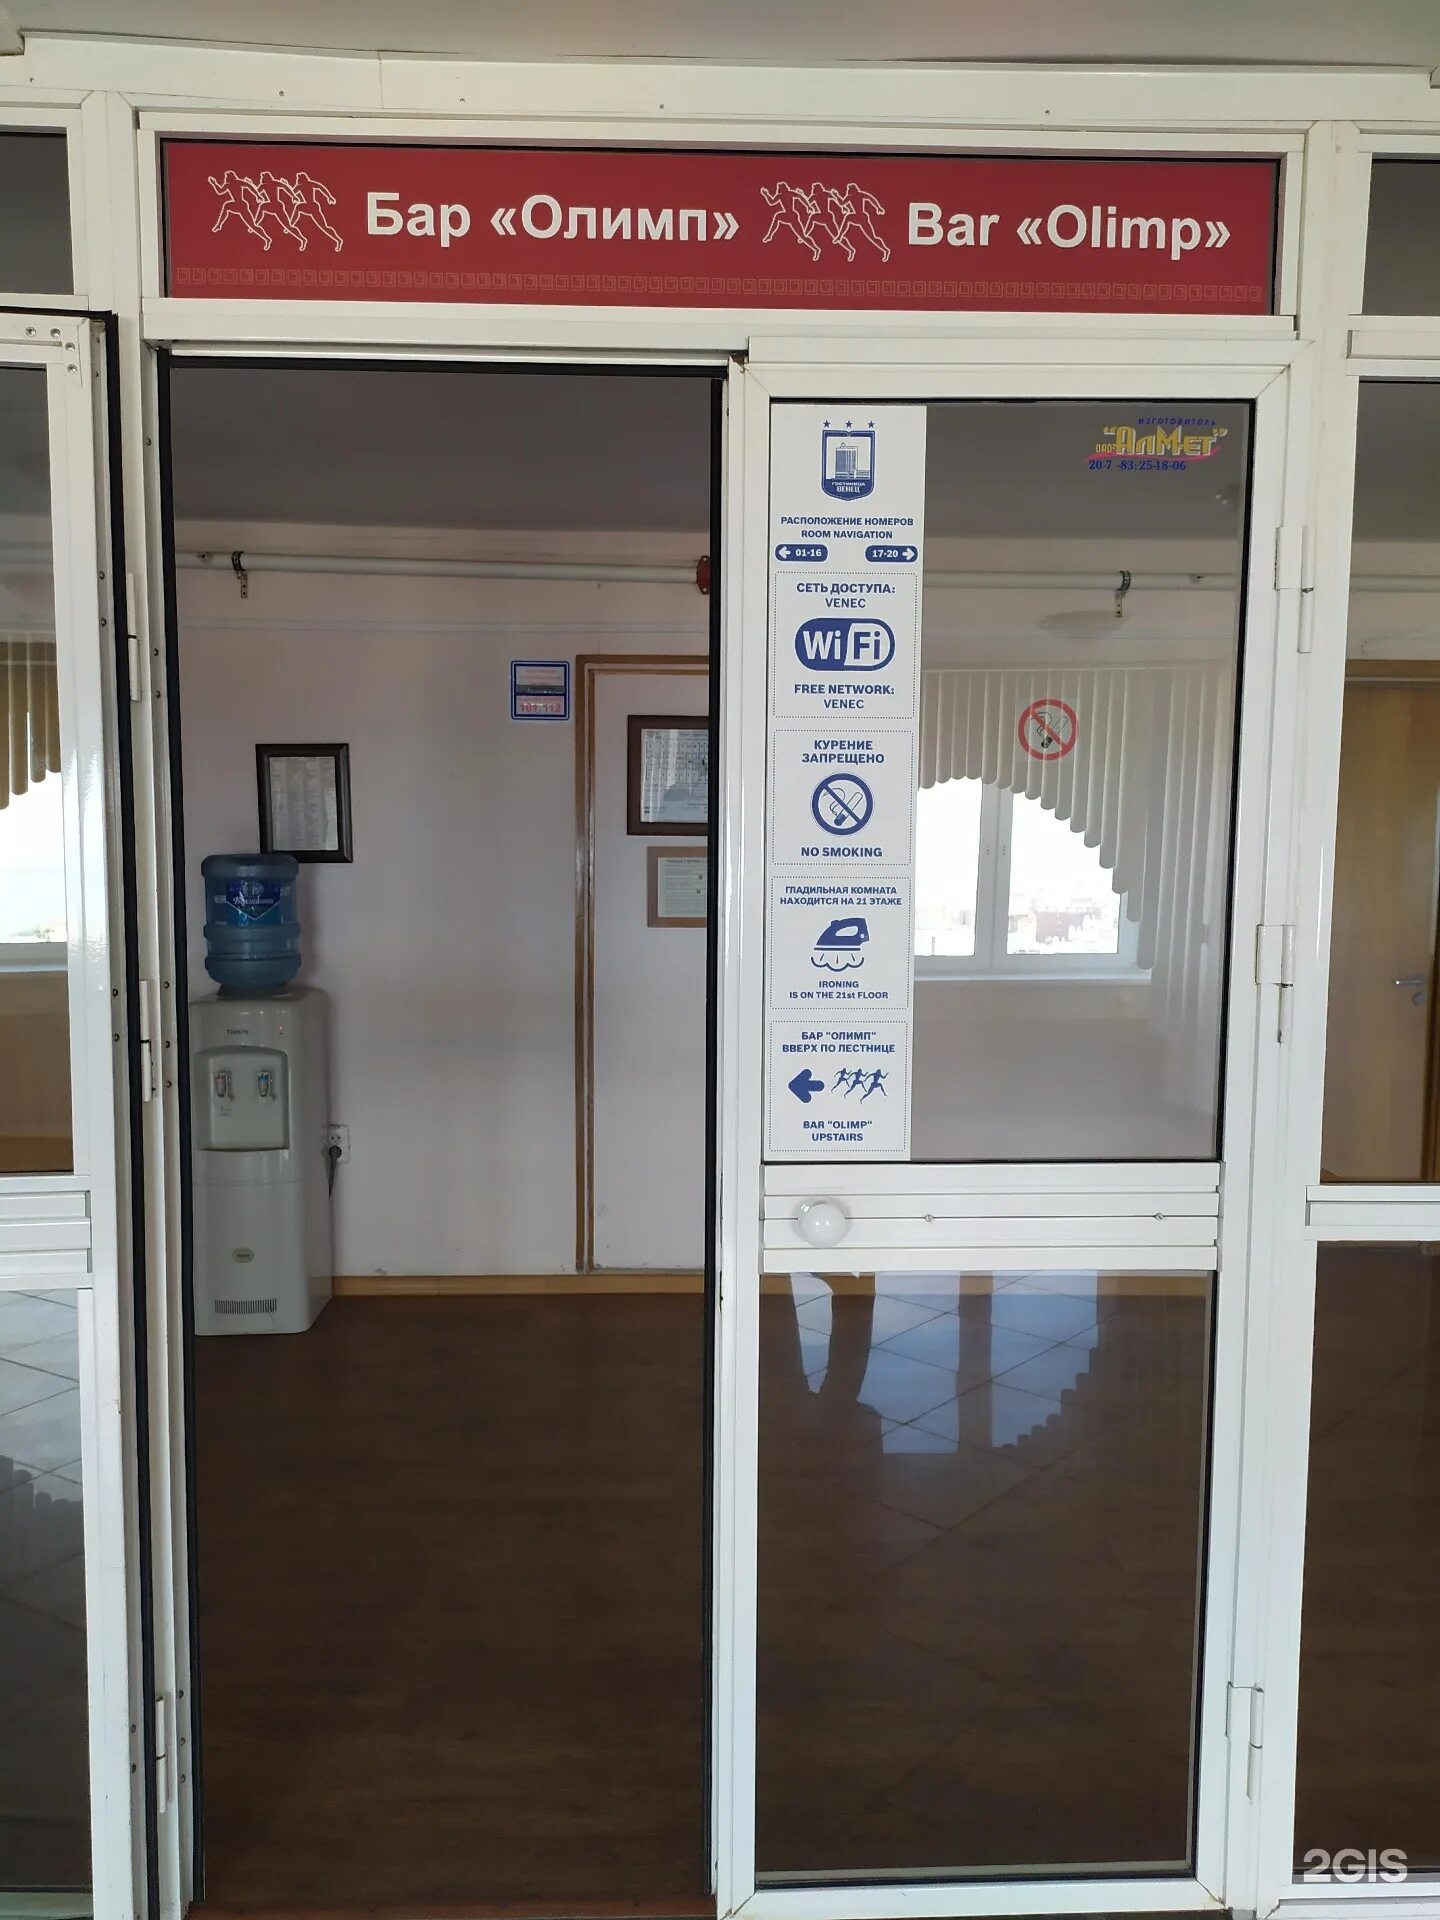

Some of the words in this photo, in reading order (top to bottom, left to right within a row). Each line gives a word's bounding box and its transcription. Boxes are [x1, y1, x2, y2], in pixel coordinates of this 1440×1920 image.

[367, 192, 470, 247] Бар
[490, 194, 740, 242] «Олимп»
[908, 202, 999, 246] Bar
[1016, 204, 1231, 261] «Olimp»
[781, 516, 862, 526] РАСПОЛОЖЕНИЕ
[865, 517, 914, 526] НОМЕРОВ
[801, 530, 831, 538] ROOM
[833, 530, 893, 539] NAVIGATION
[795, 548, 822, 557] 01-16
[872, 549, 899, 558] 17-20
[796, 582, 828, 592] СЕТЬ
[830, 583, 896, 594] ДОСТУПА:
[825, 598, 866, 608] VENEC
[794, 684, 825, 694] FREE
[828, 685, 895, 695] NETWORK:
[823, 699, 864, 709] VENEC
[814, 740, 873, 750] КУРЕНИЕ
[801, 753, 885, 765] ЗАПРЕЩЕНО
[801, 847, 820, 857] NO
[822, 847, 883, 857] SMOKING
[785, 886, 848, 895] ГЛАДИЛЬНАЯ
[851, 887, 897, 895] КОМНАТА
[780, 897, 838, 906] НАХОДИТСЯ
[870, 898, 903, 906] ЭТАЖЕ
[801, 1032, 823, 1040] БАР
[782, 1044, 818, 1052] ВВЕРХ
[820, 1044, 836, 1053] ПО
[838, 1044, 896, 1054] ЛЕСТНИЦЕ
[803, 1121, 825, 1129] BAR
[811, 1133, 864, 1142] UPSTAIRS
